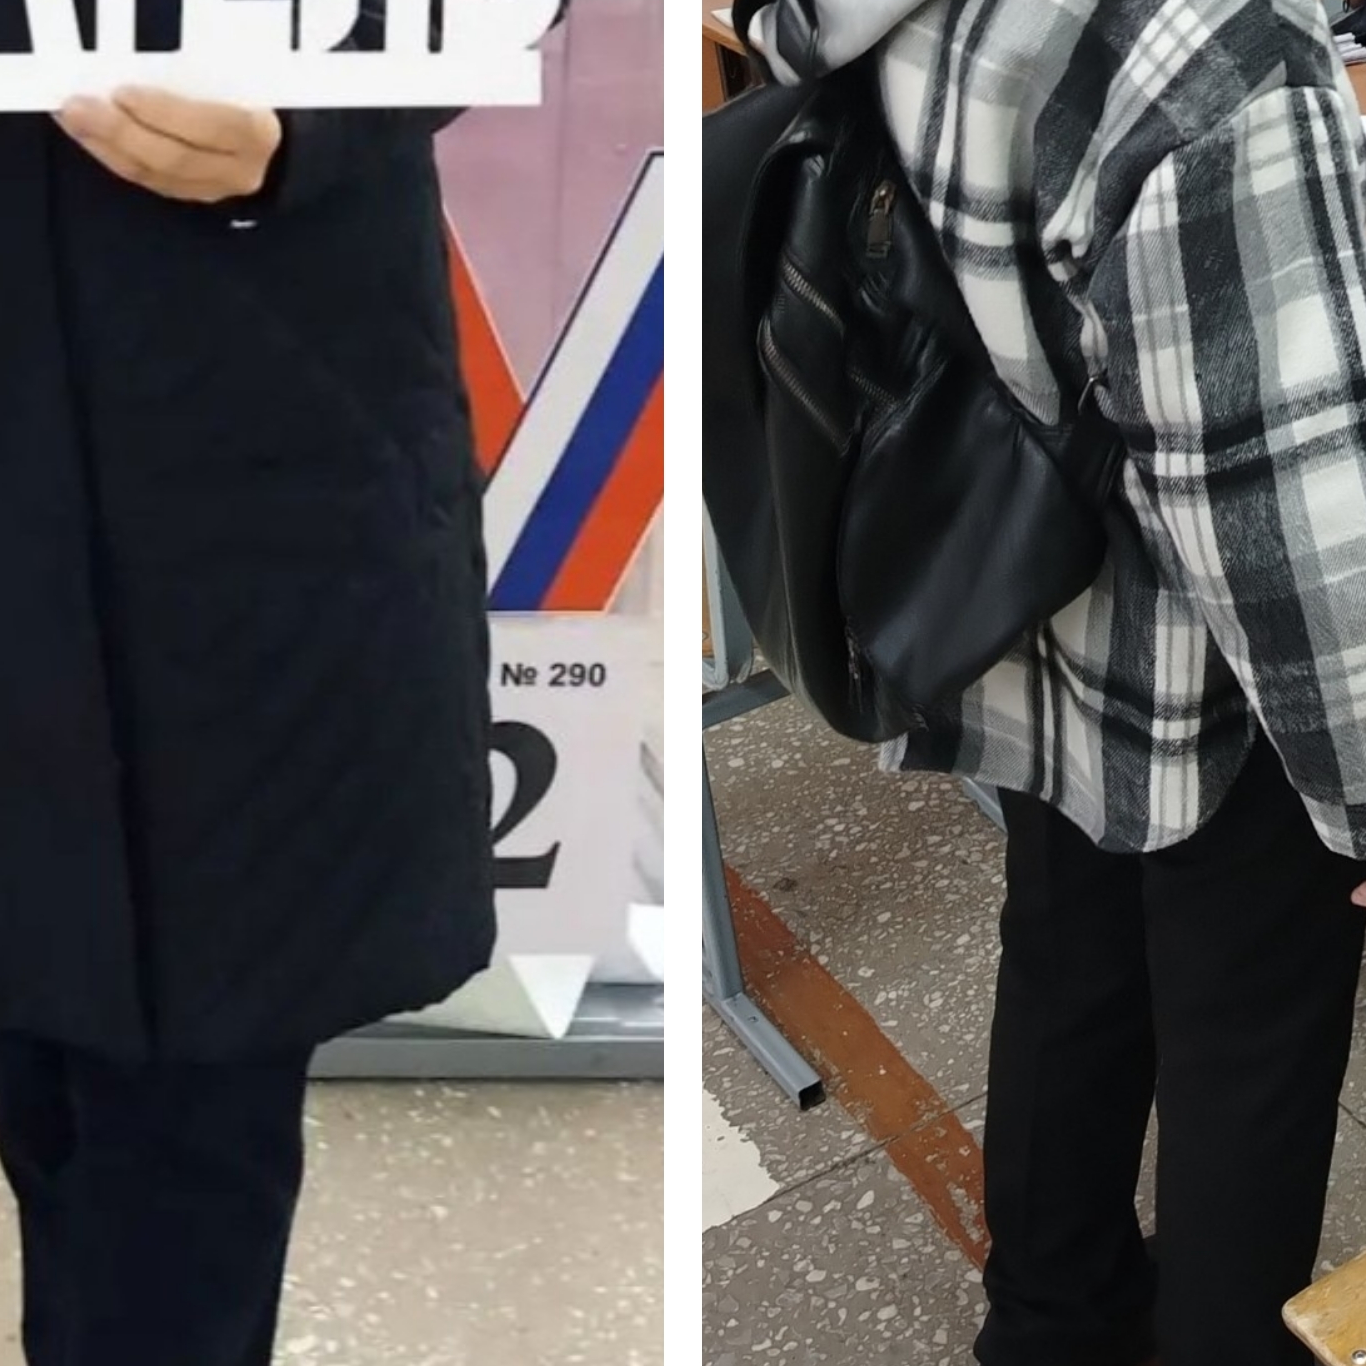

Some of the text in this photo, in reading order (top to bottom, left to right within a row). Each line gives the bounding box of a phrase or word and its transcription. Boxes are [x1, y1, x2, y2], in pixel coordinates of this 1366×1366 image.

[501, 662, 606, 687] № 290
[490, 721, 561, 889] 2
